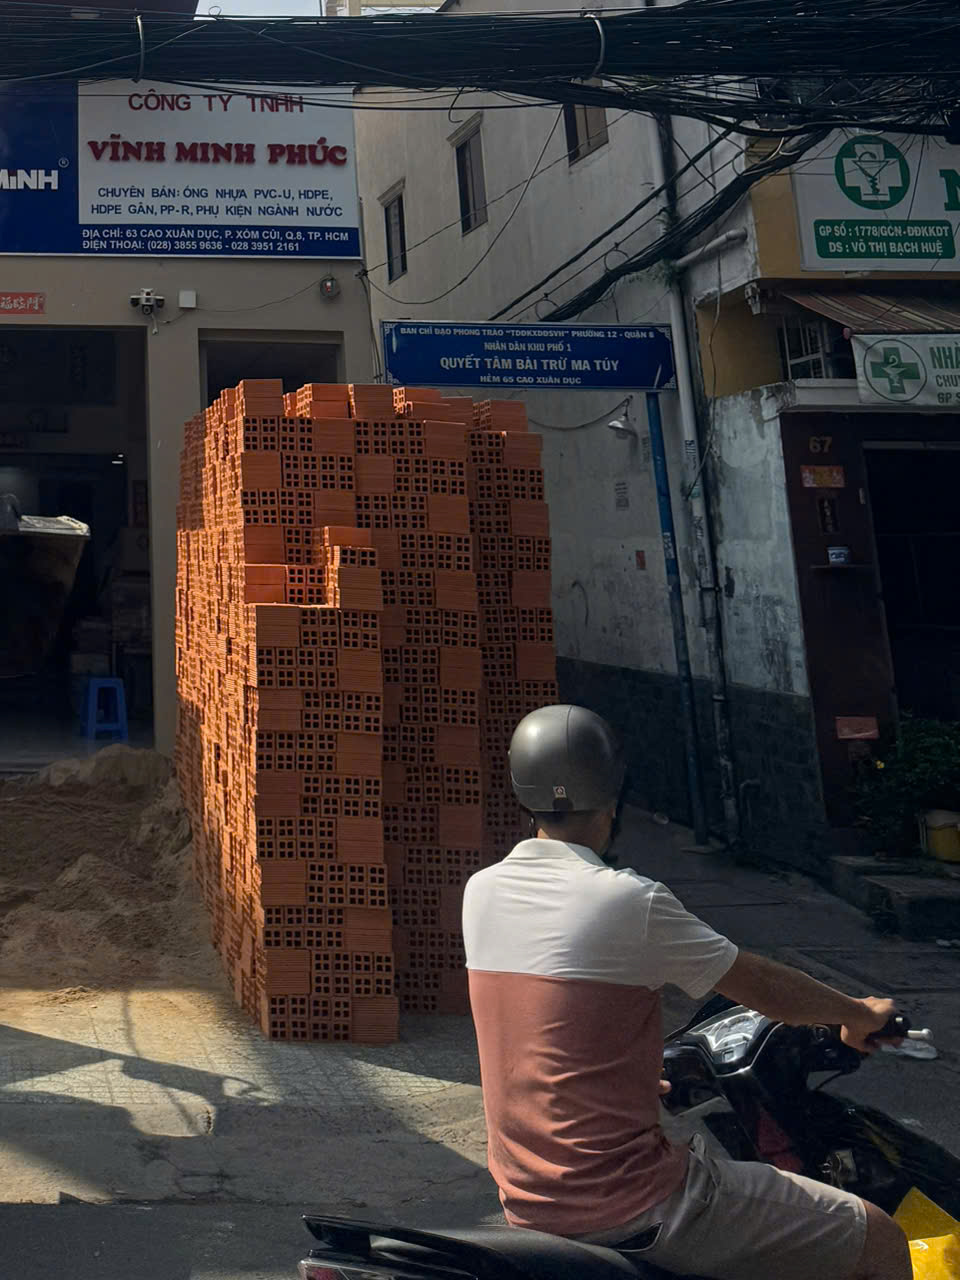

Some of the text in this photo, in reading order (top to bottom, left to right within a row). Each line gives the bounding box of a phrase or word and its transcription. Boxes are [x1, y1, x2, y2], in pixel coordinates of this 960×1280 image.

[128, 89, 303, 112] CÔNG TY TNHH
[88, 134, 347, 164] VĨNH MINH PHÚC
[98, 186, 144, 197] CHUYÊN
[215, 188, 248, 201] NHỰA
[299, 189, 333, 200] HDPE,
[91, 204, 122, 214] HDPE
[196, 205, 219, 218] PHỤ
[226, 203, 252, 218] KIỆN
[258, 203, 299, 216] NGÀNH
[307, 204, 343, 217] NƯỚC
[82, 228, 100, 239] ĐỊA
[125, 229, 138, 238] 63
[140, 229, 163, 238] CAO
[165, 228, 194, 239] XUÂN
[197, 230, 222, 241] DỤC,
[225, 230, 234, 239] P.
[235, 228, 260, 239] XÓM
[285, 231, 305, 241] Q.8,
[307, 232, 323, 241] TP.
[325, 232, 349, 241] HCM
[819, 226, 832, 236] GP
[834, 221, 847, 236] SỐ
[82, 240, 107, 251] ĐIỆN
[109, 241, 145, 251] THOẠI:
[147, 241, 172, 251] (028)
[173, 241, 198, 250] 3855
[199, 241, 223, 250] 9636
[231, 241, 249, 250] 028
[251, 242, 273, 251] 3951
[276, 242, 300, 251] 2161
[828, 242, 843, 253] DS
[851, 239, 866, 253] VÕ
[868, 242, 887, 256] THỊ
[889, 242, 919, 256] BẠCH
[921, 240, 943, 256] HUỆ
[400, 327, 417, 335] BAN
[453, 328, 480, 336] PHONG
[527, 343, 545, 351] KHU
[566, 344, 572, 352] 1
[440, 353, 620, 371] QUYẾT TÂM BÀI TRỪ MA TÚY
[808, 436, 832, 453] 67
